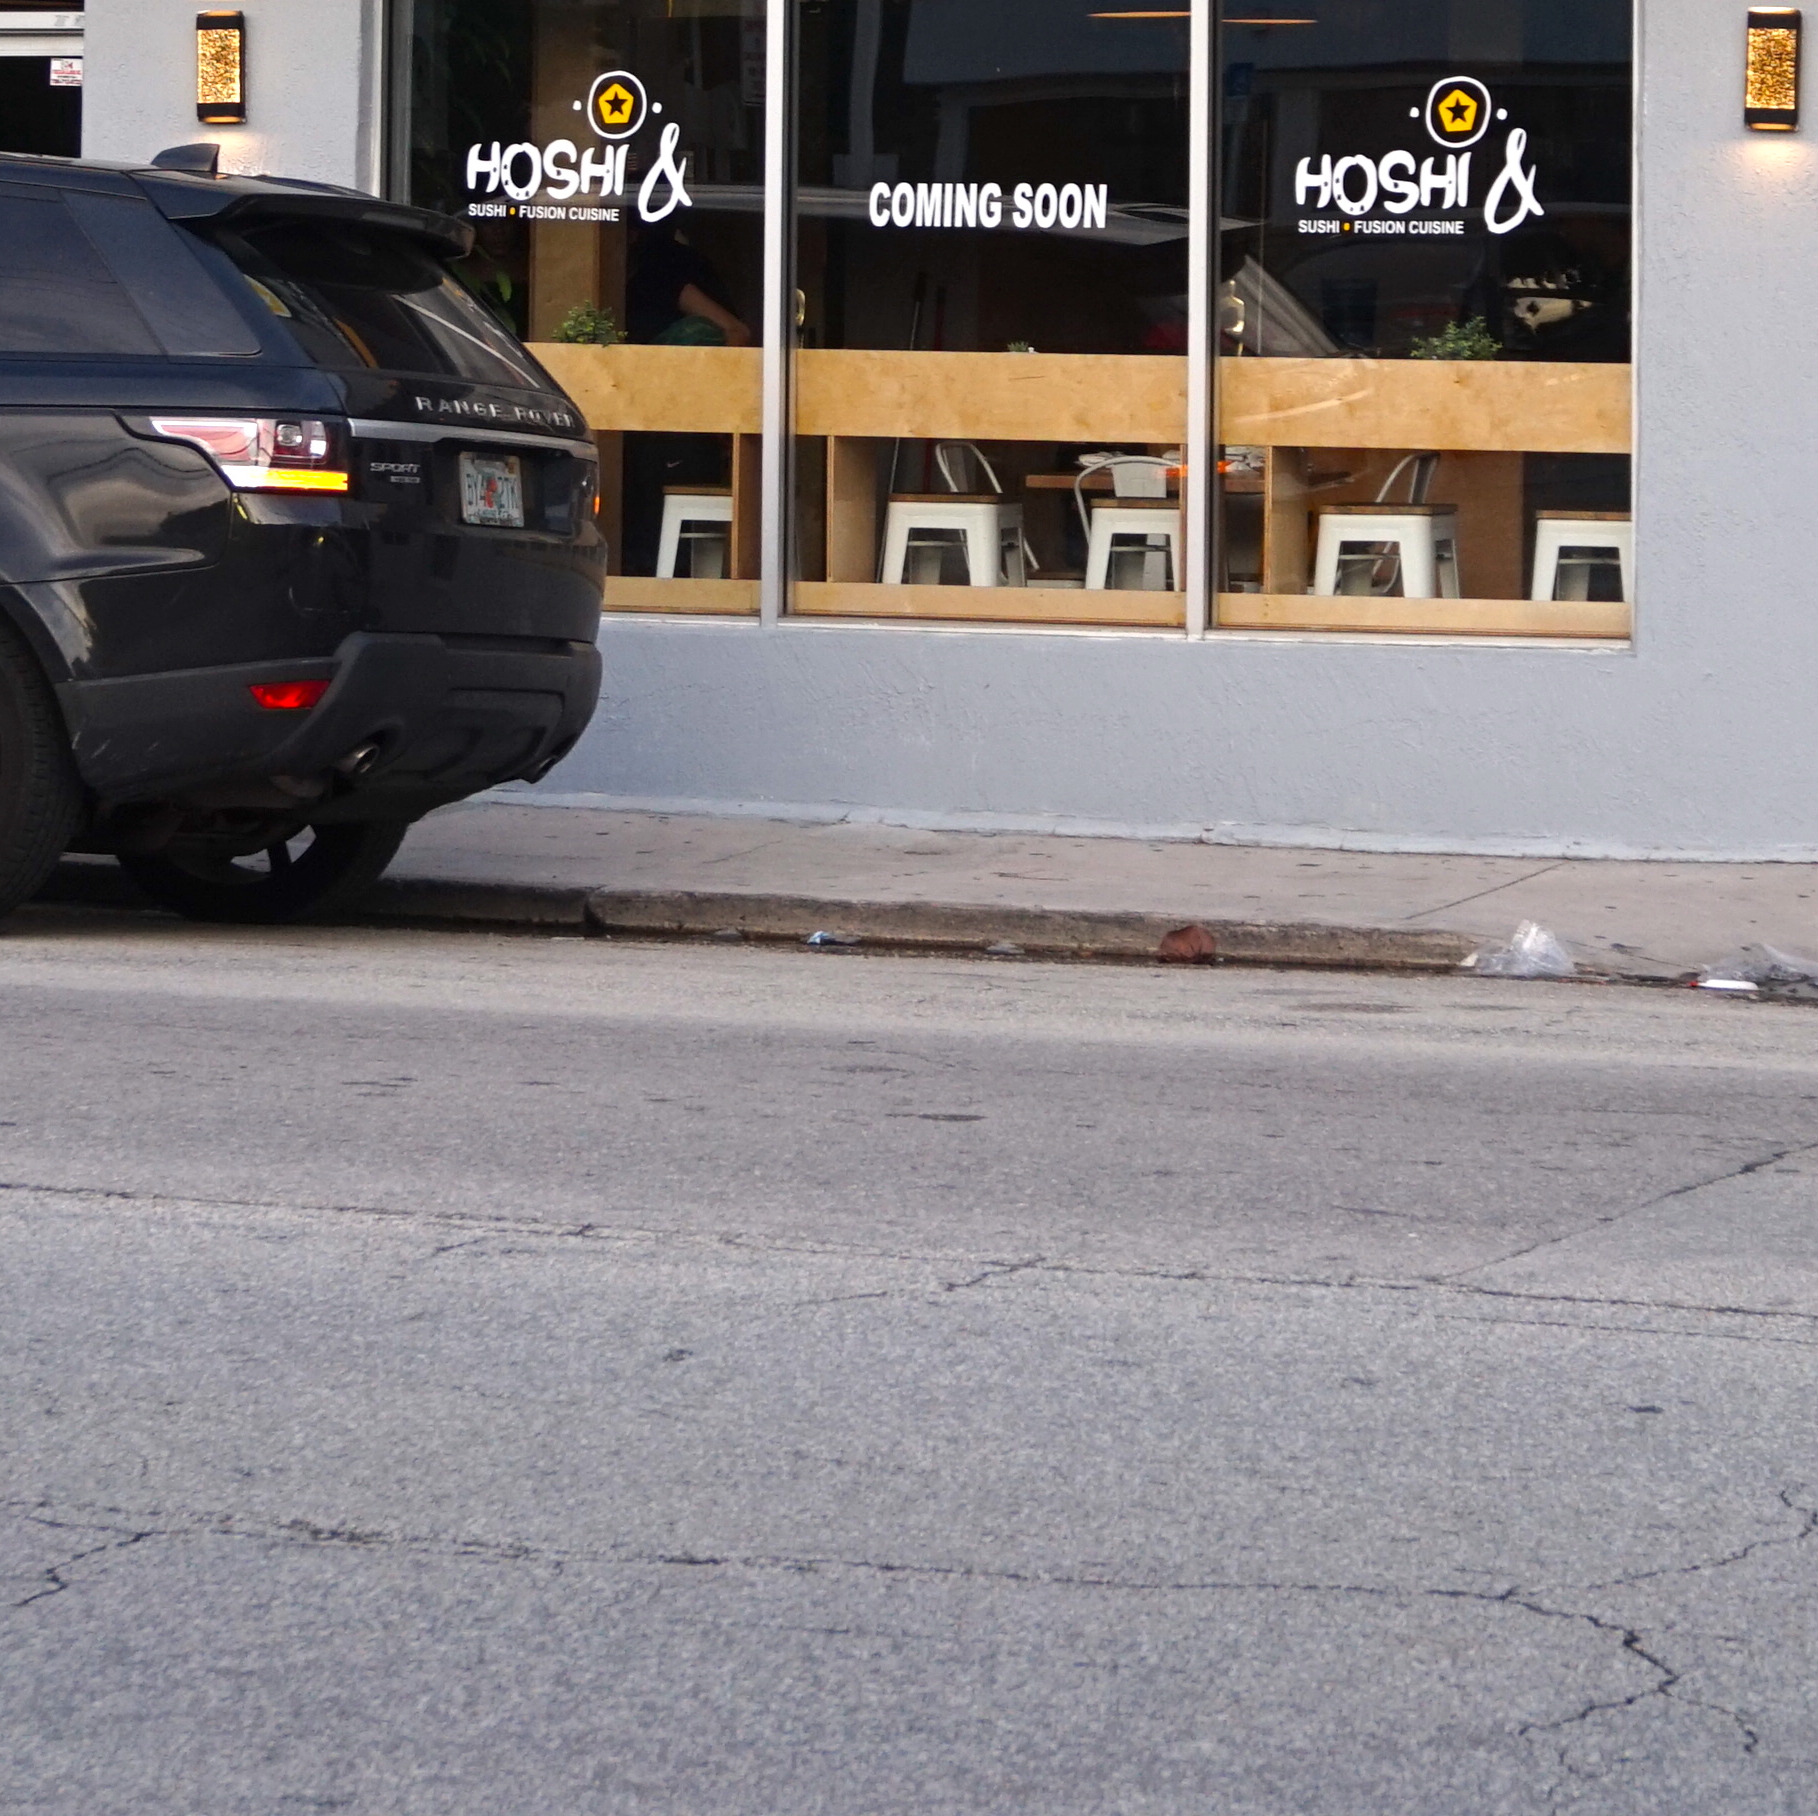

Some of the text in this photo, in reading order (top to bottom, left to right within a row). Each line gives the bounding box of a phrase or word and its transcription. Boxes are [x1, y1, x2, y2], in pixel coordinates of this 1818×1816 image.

[467, 122, 693, 222] HOSHI &
[1295, 127, 1545, 234] HOSHI &
[468, 203, 620, 222] SUSHI FUSION CUISINE
[869, 182, 1108, 229] COMING SOON
[1298, 219, 1465, 235] SUSHI FUSION CUISINE
[414, 396, 577, 428] RANGE ROVER
[370, 462, 421, 474] SPORT
